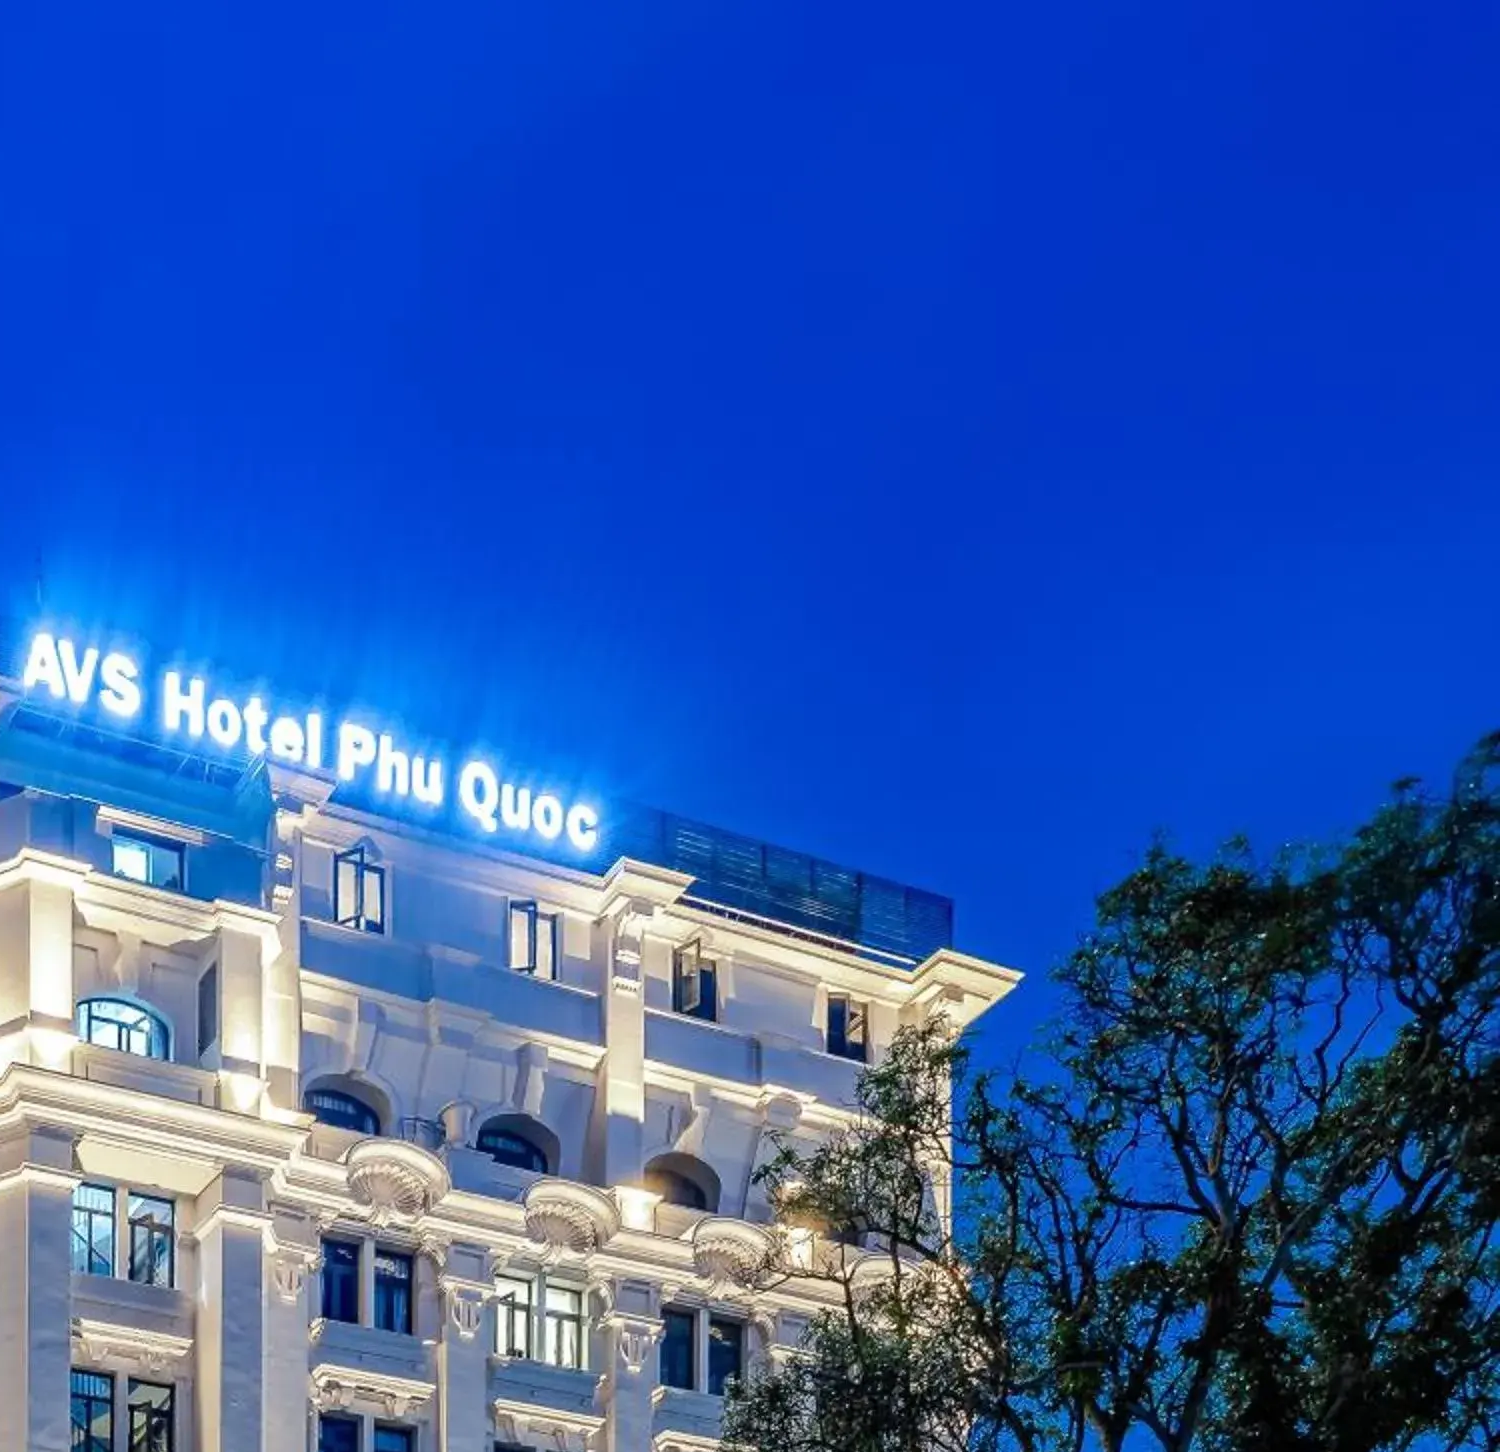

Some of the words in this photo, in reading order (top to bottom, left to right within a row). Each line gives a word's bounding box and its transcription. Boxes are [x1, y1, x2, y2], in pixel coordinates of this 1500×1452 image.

[23, 633, 141, 717] AVS
[164, 671, 321, 769] Hotel
[337, 722, 443, 804] Phu
[460, 761, 597, 851] Quoc
